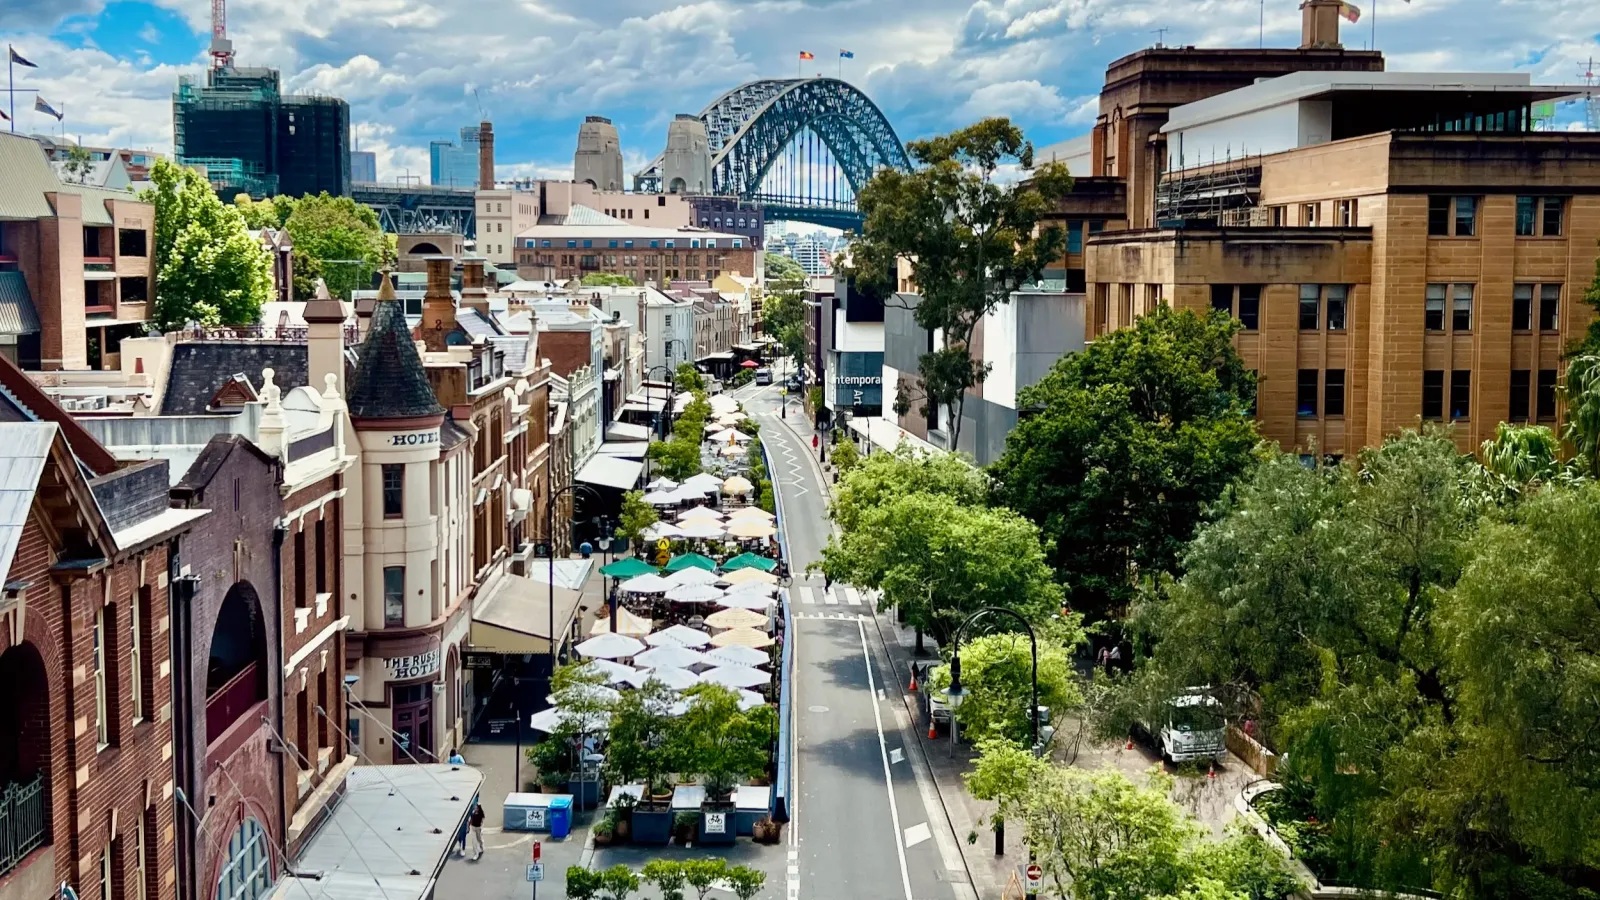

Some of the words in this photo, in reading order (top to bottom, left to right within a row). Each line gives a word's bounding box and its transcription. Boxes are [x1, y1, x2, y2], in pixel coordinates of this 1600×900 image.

[836, 375, 883, 387] ntempora
[853, 389, 864, 405] Art
[382, 657, 410, 669] THE
[394, 662, 438, 679] HOTE
